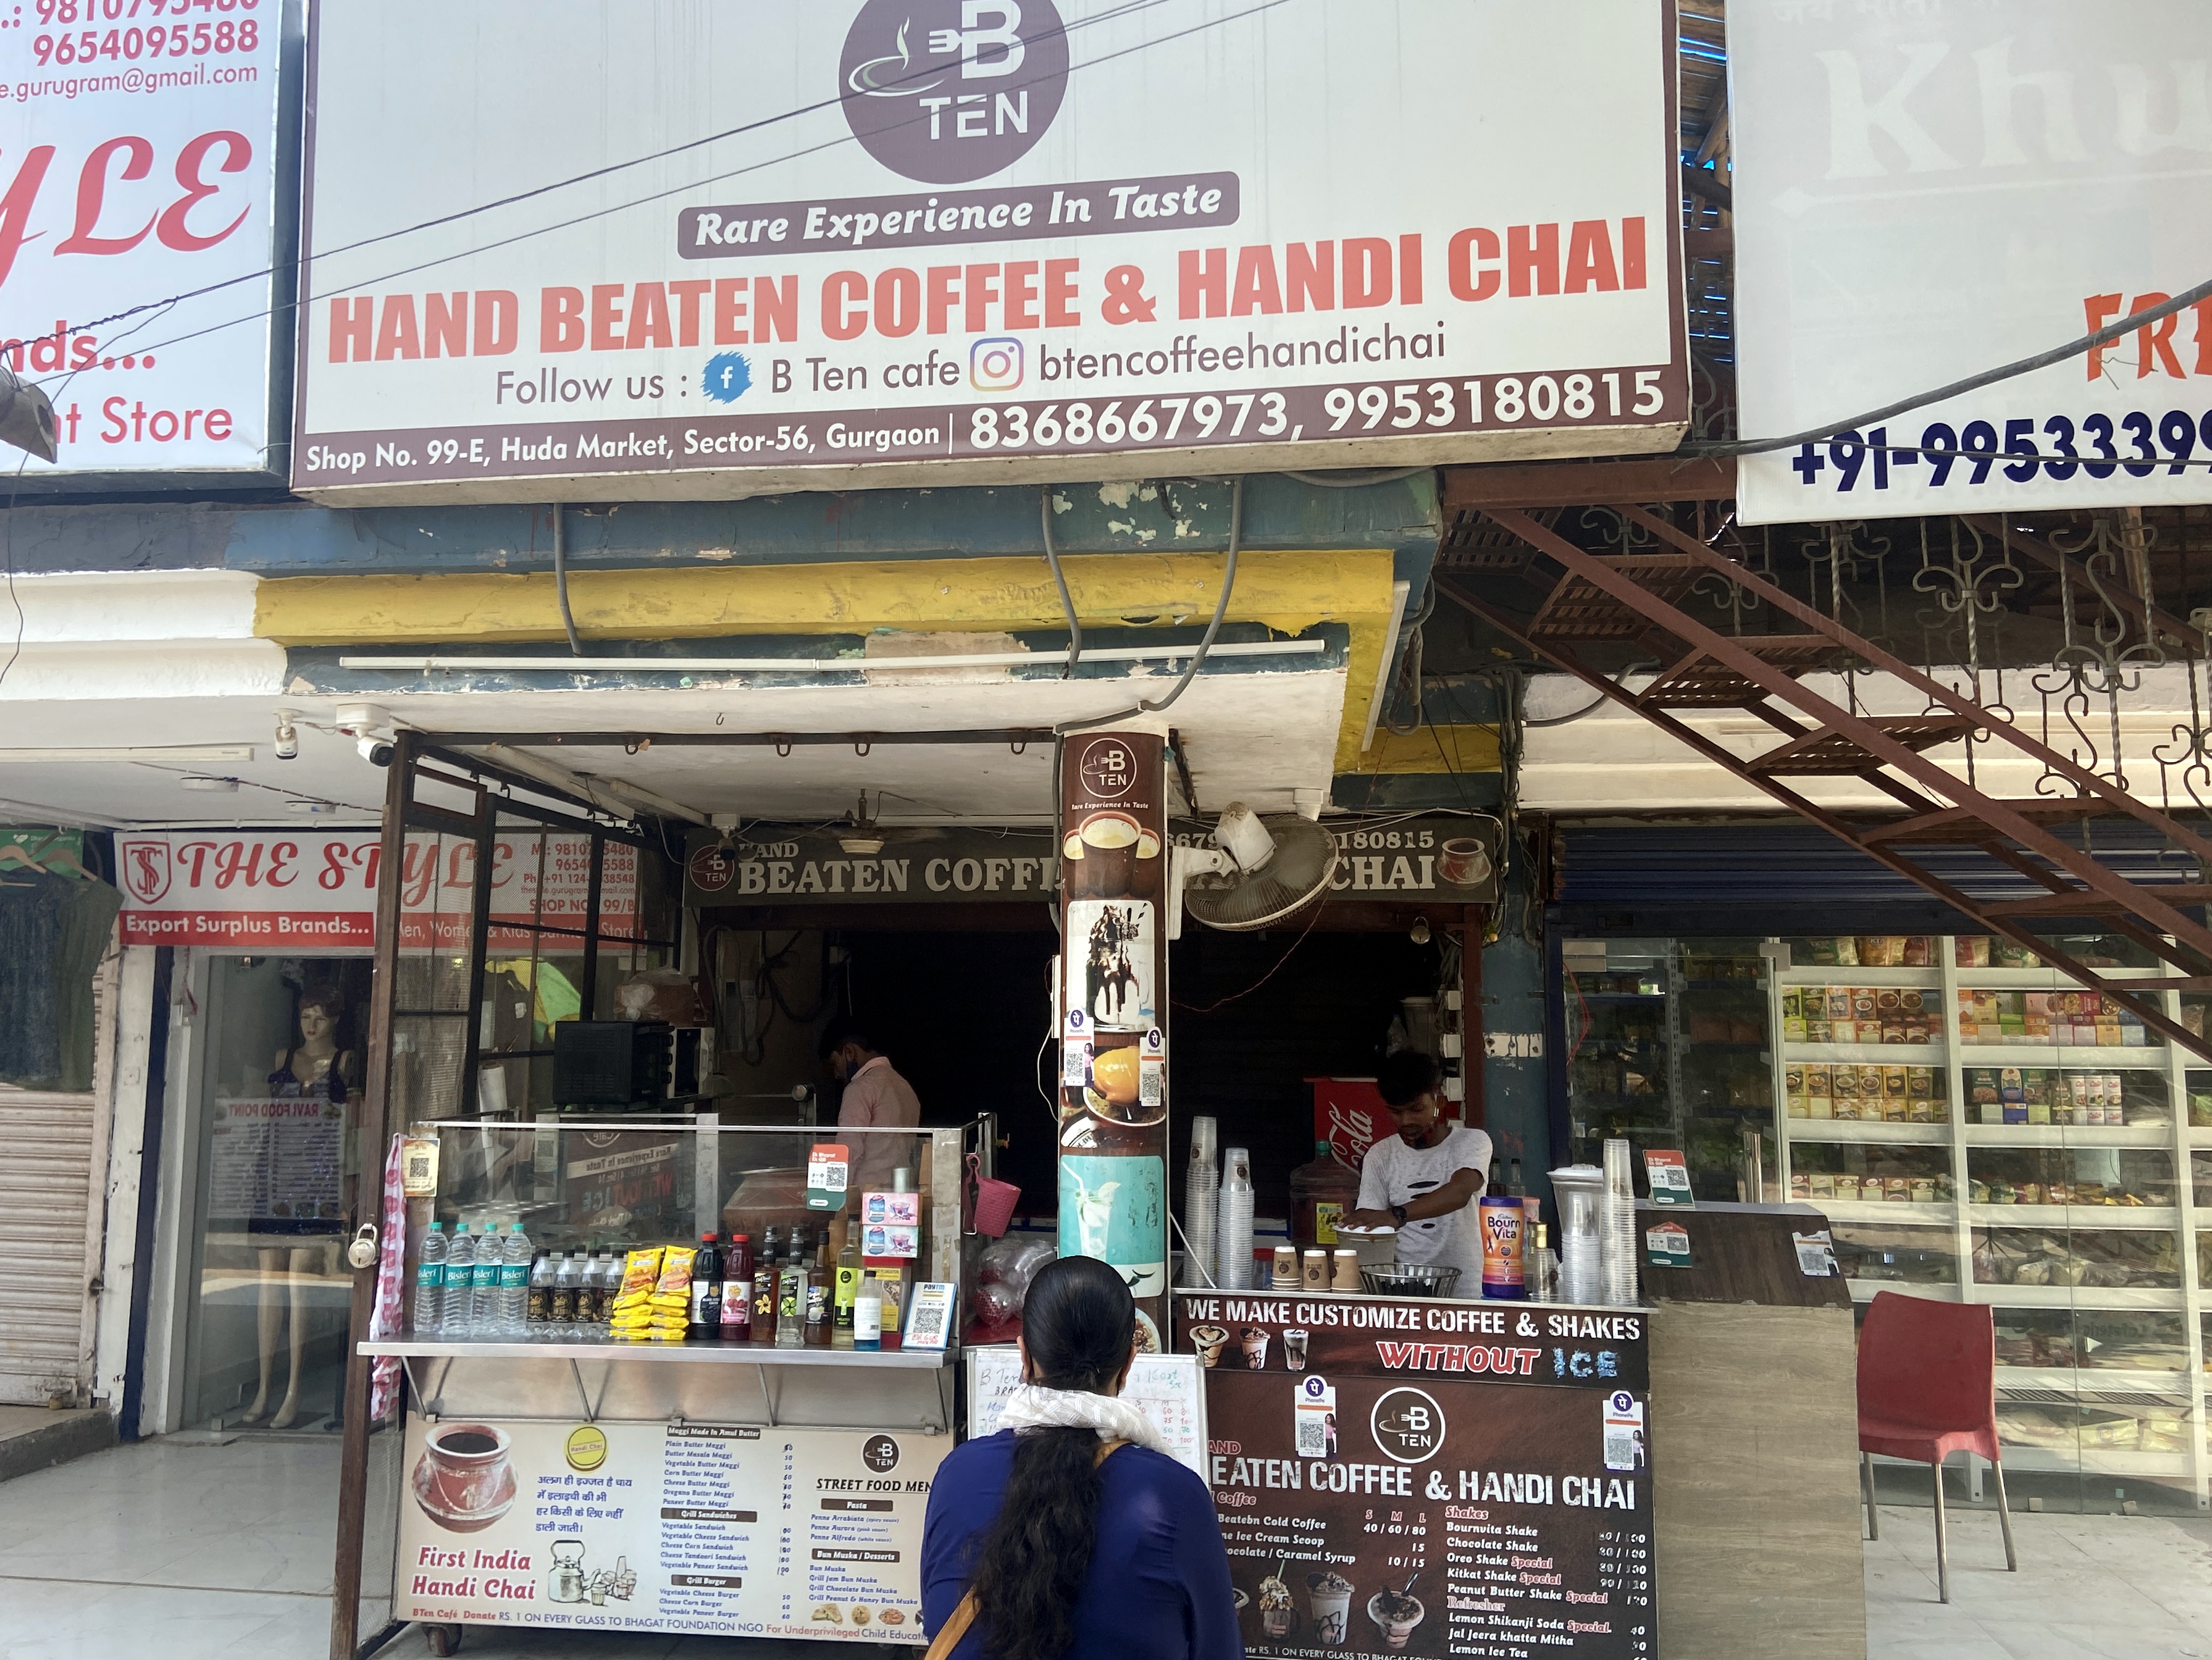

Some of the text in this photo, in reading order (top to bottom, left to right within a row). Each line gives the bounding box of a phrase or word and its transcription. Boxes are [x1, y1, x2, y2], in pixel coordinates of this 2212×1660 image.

[33, 19, 259, 66] 9654095588
[959, 0, 1026, 78] B
[0, 63, 258, 103] e.gurugram@gmail.com
[919, 91, 1029, 142] TEN
[695, 184, 1222, 248] Rare Experience In Taste
[329, 217, 1648, 363] HAND BEATEN COFFEE & HANDI CHAI
[1039, 321, 1446, 382] btencoffeehandichai
[771, 350, 960, 393] B Ten cafe
[495, 368, 664, 405] Follow us
[100, 396, 232, 443] Store
[969, 371, 1664, 449] 8368667973, 9953180815
[306, 424, 939, 474] Shop No. 99-E, Huda Market, Sector-56, Gurgaon
[1109, 750, 1126, 771] B
[1099, 774, 1126, 786] TEN
[1084, 801, 1121, 810] Experience
[556, 842, 634, 856] 98105480
[739, 842, 798, 858] AND
[178, 841, 298, 889] THE
[1329, 855, 1436, 891] CHAI
[705, 873, 726, 882] TEN
[738, 859, 910, 894] BEATEN
[603, 899, 635, 913] 99/B
[126, 915, 369, 936] Export Surplus Brands...
[1488, 1217, 1520, 1228] Bourn
[1493, 1227, 1517, 1240] Vita
[447, 1267, 472, 1281] Bisleri
[501, 1266, 524, 1280] Bisleri
[1186, 1299, 1641, 1341] WE MAKE CUSTOMIZE COFFEE & SHAKES
[1376, 1340, 1619, 1379] WITHOUT ICE
[1410, 1406, 1428, 1431] B
[1398, 1433, 1431, 1448] TEN
[875, 1458, 894, 1467] TEN
[564, 1475, 574, 1486] ही
[606, 1476, 614, 1487] है
[616, 1478, 632, 1488] चाय
[816, 1478, 901, 1491] STREET FOOD
[1212, 1457, 1636, 1511] EATEN COFFEE & HANDI CHAI
[582, 1491, 594, 1501] की
[596, 1491, 608, 1502] भी
[847, 1501, 868, 1509] Pasta
[1217, 1491, 1257, 1507] Coffee
[1365, 1509, 1426, 1524] S M L
[1445, 1506, 1489, 1520] Shakes
[1263, 1516, 1289, 1527] Cold
[1291, 1518, 1326, 1531] Coffee
[1364, 1524, 1378, 1533] 40
[1388, 1525, 1402, 1535] 60
[1412, 1526, 1426, 1536] 80
[1446, 1522, 1538, 1536] Bournvita Shake
[1236, 1531, 1425, 1553] Ice Cream Scoop 15
[1446, 1537, 1538, 1552] Chocolate Shake
[418, 1546, 531, 1571] First India
[817, 1550, 895, 1561] Bun Muska Desserts
[1276, 1548, 1356, 1565] Caramel Syrup
[1447, 1553, 1553, 1569] Oreo Shake Special
[1447, 1567, 1562, 1586] Kitkat Shake Special
[411, 1575, 536, 1600] Handi Chai
[1447, 1583, 1608, 1604] Peanut Butter Shake Special
[1447, 1596, 1506, 1612] Refresher
[524, 1613, 541, 1623] ON
[544, 1614, 572, 1624] EVERY
[576, 1616, 605, 1626] GLASS
[608, 1616, 622, 1627] TO
[625, 1617, 664, 1629] BHAGAT
[667, 1619, 735, 1631] FOUNDATION
[738, 1623, 764, 1633] NGO
[766, 1624, 782, 1634] For
[785, 1625, 860, 1639] Underprivileged
[861, 1628, 887, 1638] Child
[1449, 1612, 1485, 1624] Lemon
[1488, 1614, 1534, 1629] Shikanji
[1536, 1618, 1564, 1630] Soda
[1449, 1643, 1528, 1658] Lemon Ice Tea
